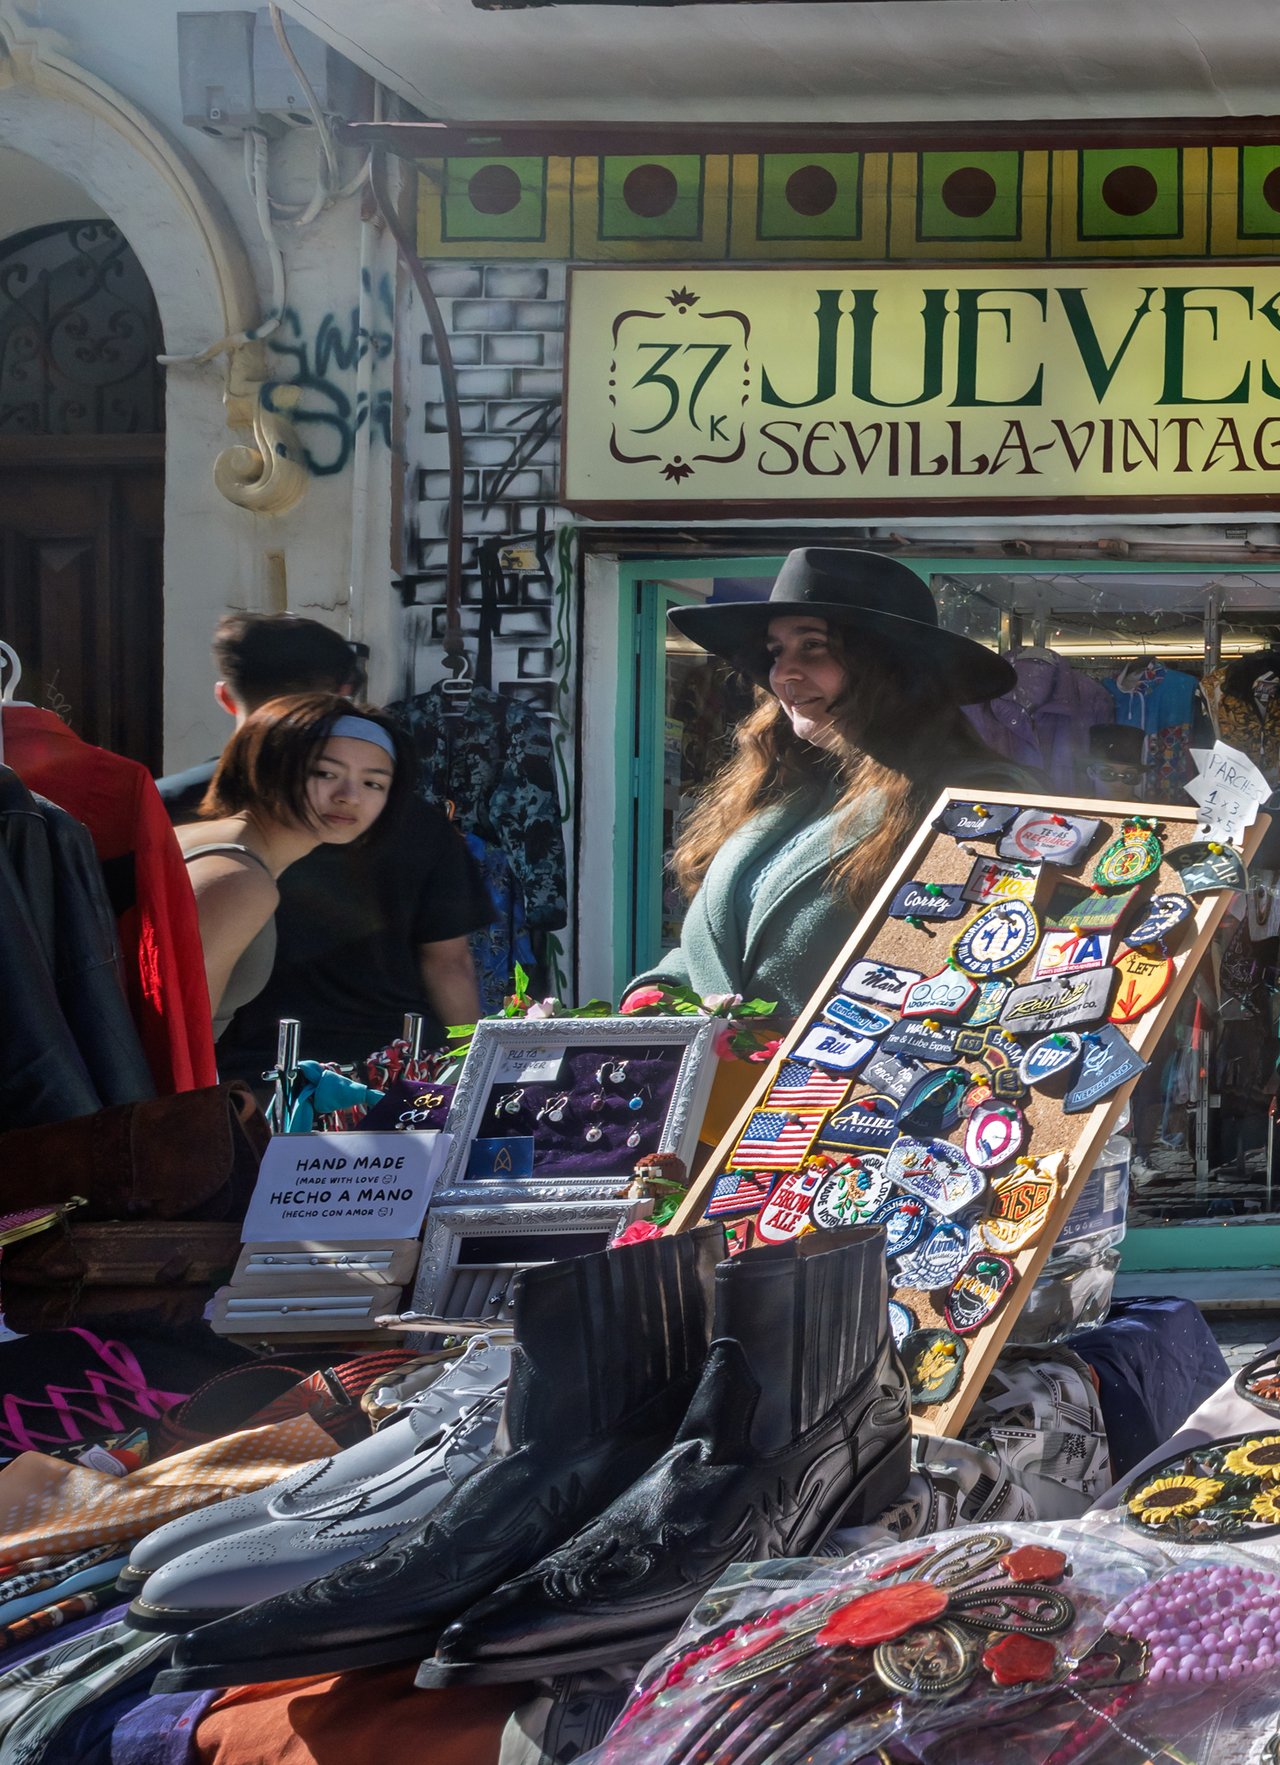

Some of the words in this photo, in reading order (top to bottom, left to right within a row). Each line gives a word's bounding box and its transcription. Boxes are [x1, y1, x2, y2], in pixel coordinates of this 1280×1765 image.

[628, 341, 732, 435] 37
[1023, 832, 1075, 847] RECHARGE
[1126, 960, 1158, 977] LEFT
[815, 1036, 851, 1056] Bill
[907, 1037, 929, 1049] Lube
[1029, 1047, 1070, 1069] FIAT
[1074, 1060, 1133, 1101] NEDERLAND
[834, 1124, 891, 1137] SECURITY
[296, 1158, 347, 1172] HAND
[353, 1156, 405, 1170] MADE
[295, 1176, 327, 1186] (MADE
[330, 1176, 353, 1184] WITH
[355, 1176, 380, 1184] LOVE
[270, 1190, 332, 1205] HECHO
[338, 1190, 350, 1203] A
[357, 1188, 413, 1203] MANO
[770, 1188, 811, 1215] BROW
[816, 1180, 838, 1207] MADE
[873, 1180, 890, 1206] LOVE
[282, 1209, 319, 1219] (HECHO
[321, 1209, 343, 1218] CON
[345, 1208, 375, 1217] AMOR
[765, 1209, 803, 1233] ALE
